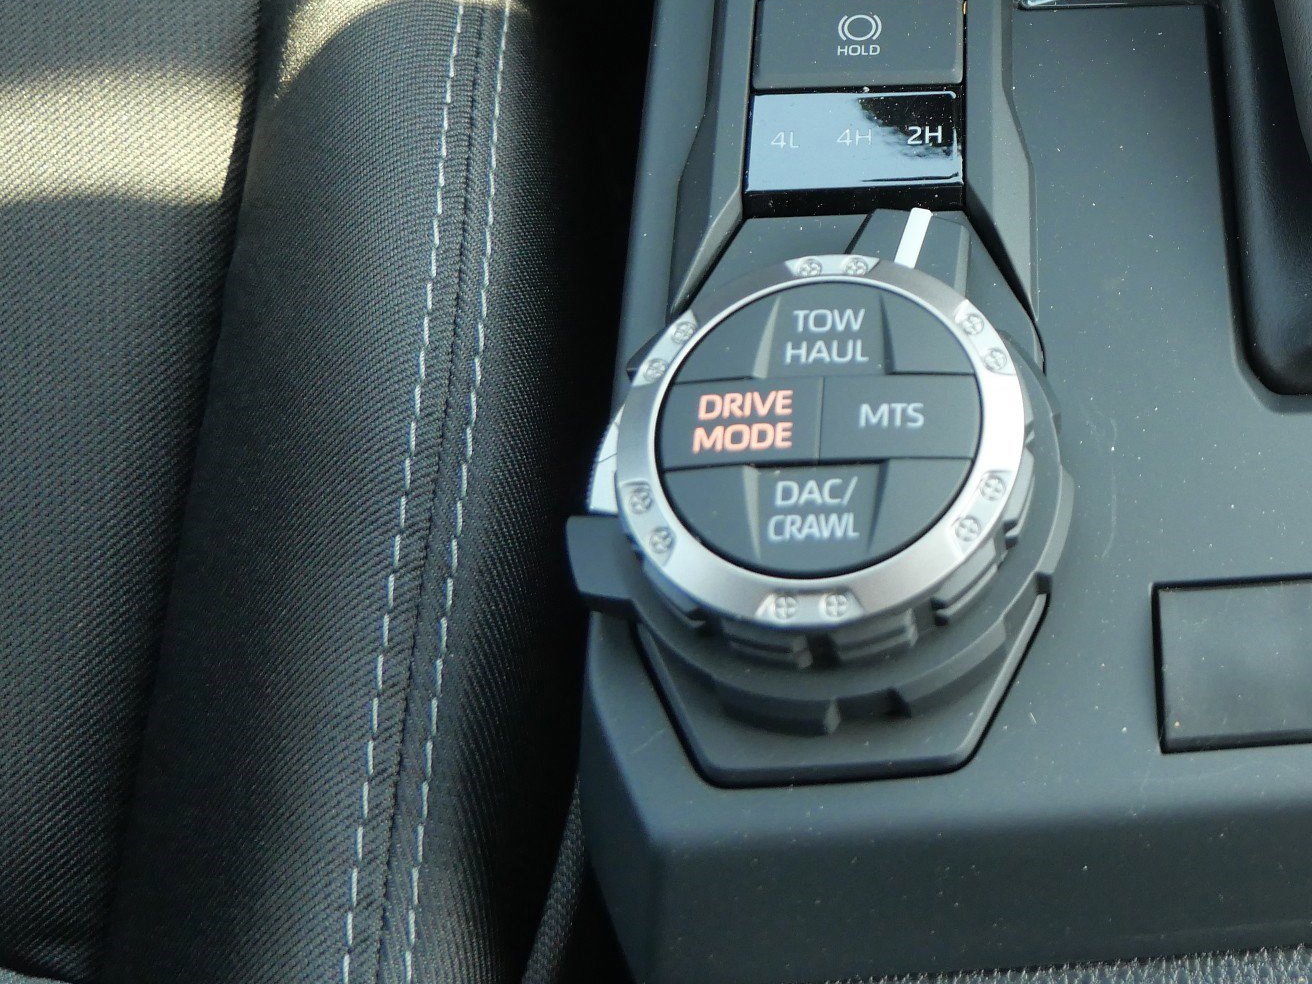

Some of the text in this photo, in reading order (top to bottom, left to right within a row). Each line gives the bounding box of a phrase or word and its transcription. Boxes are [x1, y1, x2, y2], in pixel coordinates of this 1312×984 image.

[836, 43, 881, 57] HOLD
[770, 124, 943, 150] 4L 4H 2H
[793, 308, 866, 333] TOW
[784, 340, 870, 365] HAUL
[698, 389, 794, 421] DRIVE
[858, 401, 926, 430] MTS
[692, 421, 794, 454] MODE
[773, 475, 859, 510] DAC/
[766, 512, 861, 544] CRAWL
